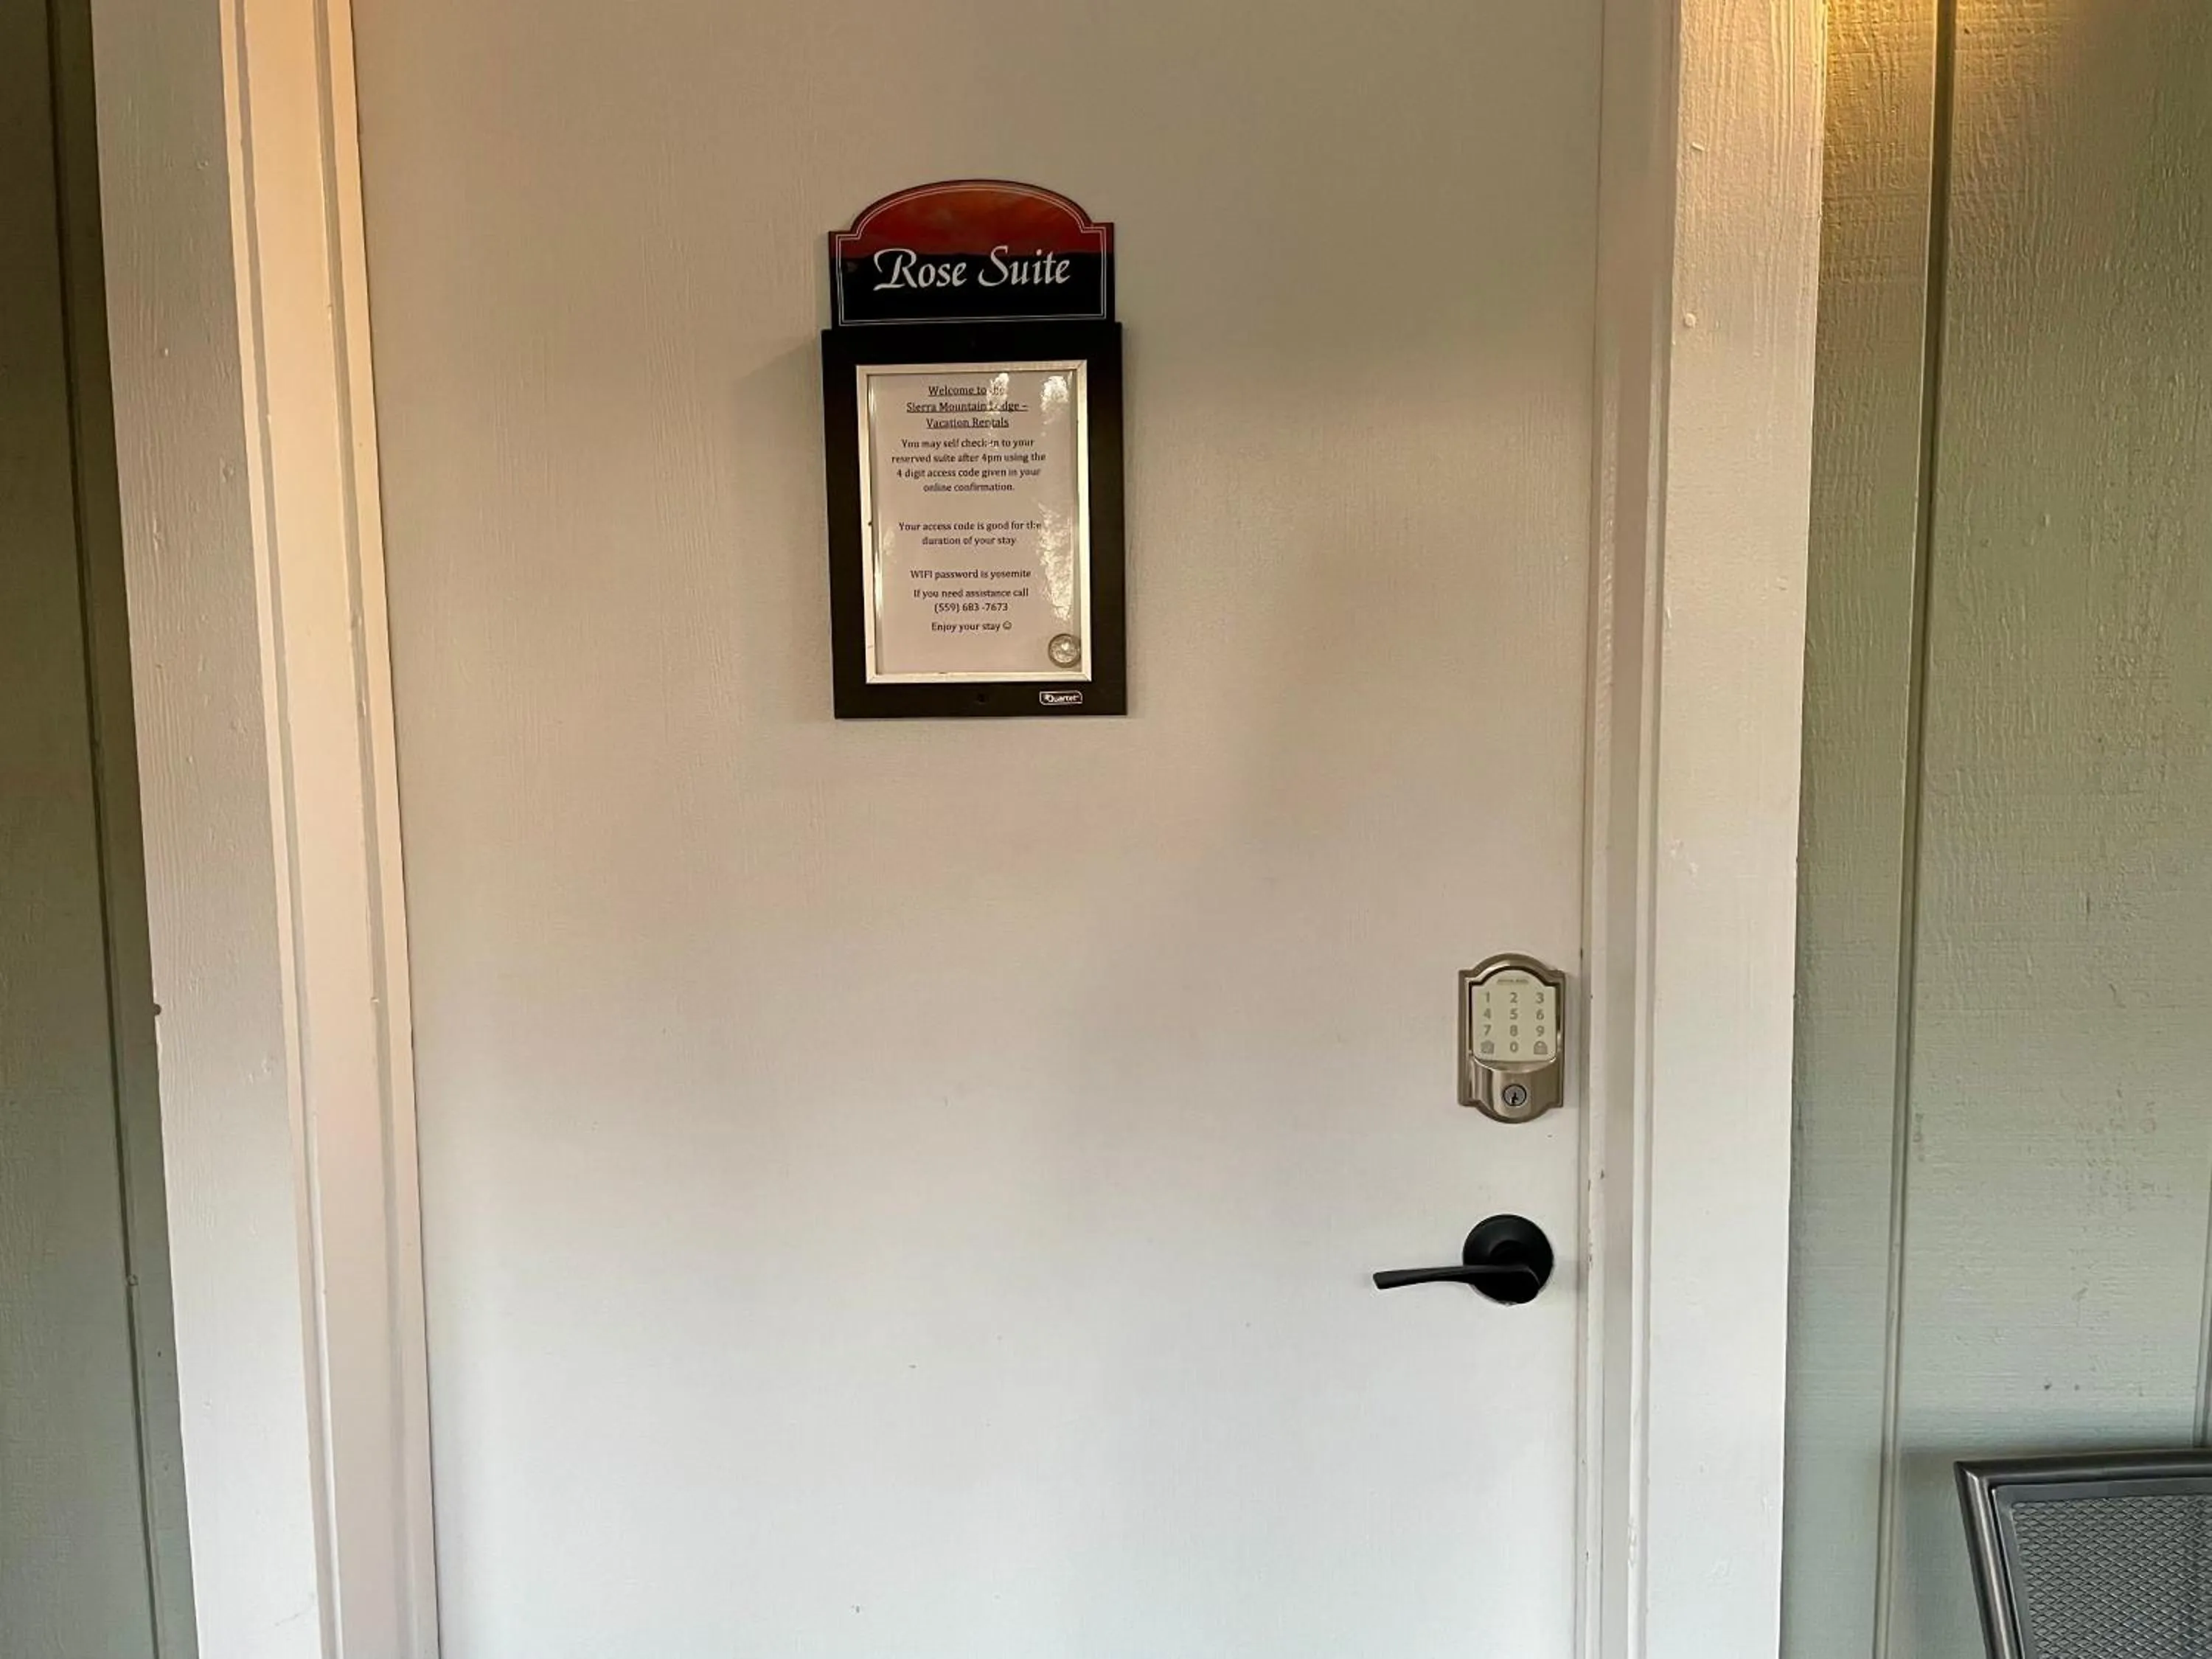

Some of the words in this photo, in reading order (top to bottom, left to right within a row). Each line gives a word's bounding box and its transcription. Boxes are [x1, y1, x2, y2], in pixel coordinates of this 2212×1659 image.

[873, 248, 967, 291] Rose
[978, 245, 1071, 287] Suite
[928, 386, 974, 396] Welcome
[975, 386, 987, 395] to
[906, 403, 936, 412] Sierra
[939, 402, 987, 412] Mountain
[989, 401, 1019, 412] Ldge
[926, 418, 970, 428] Vacation
[972, 417, 1009, 428] Rentals
[901, 439, 919, 448] You
[922, 440, 940, 449] may
[943, 438, 959, 448] self
[1001, 439, 1011, 447] to
[1012, 439, 1034, 449] your
[891, 454, 931, 463] reserved
[933, 453, 956, 462] suite
[958, 453, 979, 462] after
[981, 453, 1002, 464] 4pm
[1004, 453, 1029, 463] using
[1032, 451, 1046, 461] the
[897, 468, 902, 477] 4
[905, 467, 925, 479] digit
[959, 467, 980, 477] code
[981, 469, 1006, 478] given
[1008, 468, 1018, 476] in
[1019, 469, 1040, 478] your
[923, 482, 952, 492] online
[899, 522, 920, 531] Your
[953, 521, 975, 530] code
[977, 521, 984, 530] is
[986, 521, 1009, 532] good
[1011, 521, 1024, 529] for
[922, 536, 961, 545] duration
[963, 535, 973, 544] of
[974, 538, 995, 546] your
[911, 570, 933, 579] WIFI
[934, 569, 978, 580] password
[981, 570, 988, 578] is
[990, 570, 1032, 580] yosemite
[914, 589, 921, 598] If
[922, 591, 939, 599] you
[942, 588, 963, 597] need
[965, 589, 1012, 597] assistance
[1012, 588, 1029, 597] call
[934, 603, 960, 613] (559)
[962, 603, 979, 612] 683
[931, 622, 956, 633] Enjoy
[959, 623, 980, 632] your
[982, 622, 1001, 632] stay
[1485, 991, 1490, 1003] 1
[1509, 992, 1518, 1003] 2
[1536, 992, 1545, 1003] 3
[1484, 1008, 1492, 1019] 4
[1510, 1008, 1518, 1020] 5
[1537, 1008, 1545, 1020] 6
[1483, 1025, 1492, 1036] 7
[1509, 1024, 1518, 1036] 8
[1536, 1025, 1545, 1037] 9
[1509, 1041, 1518, 1053] 0
